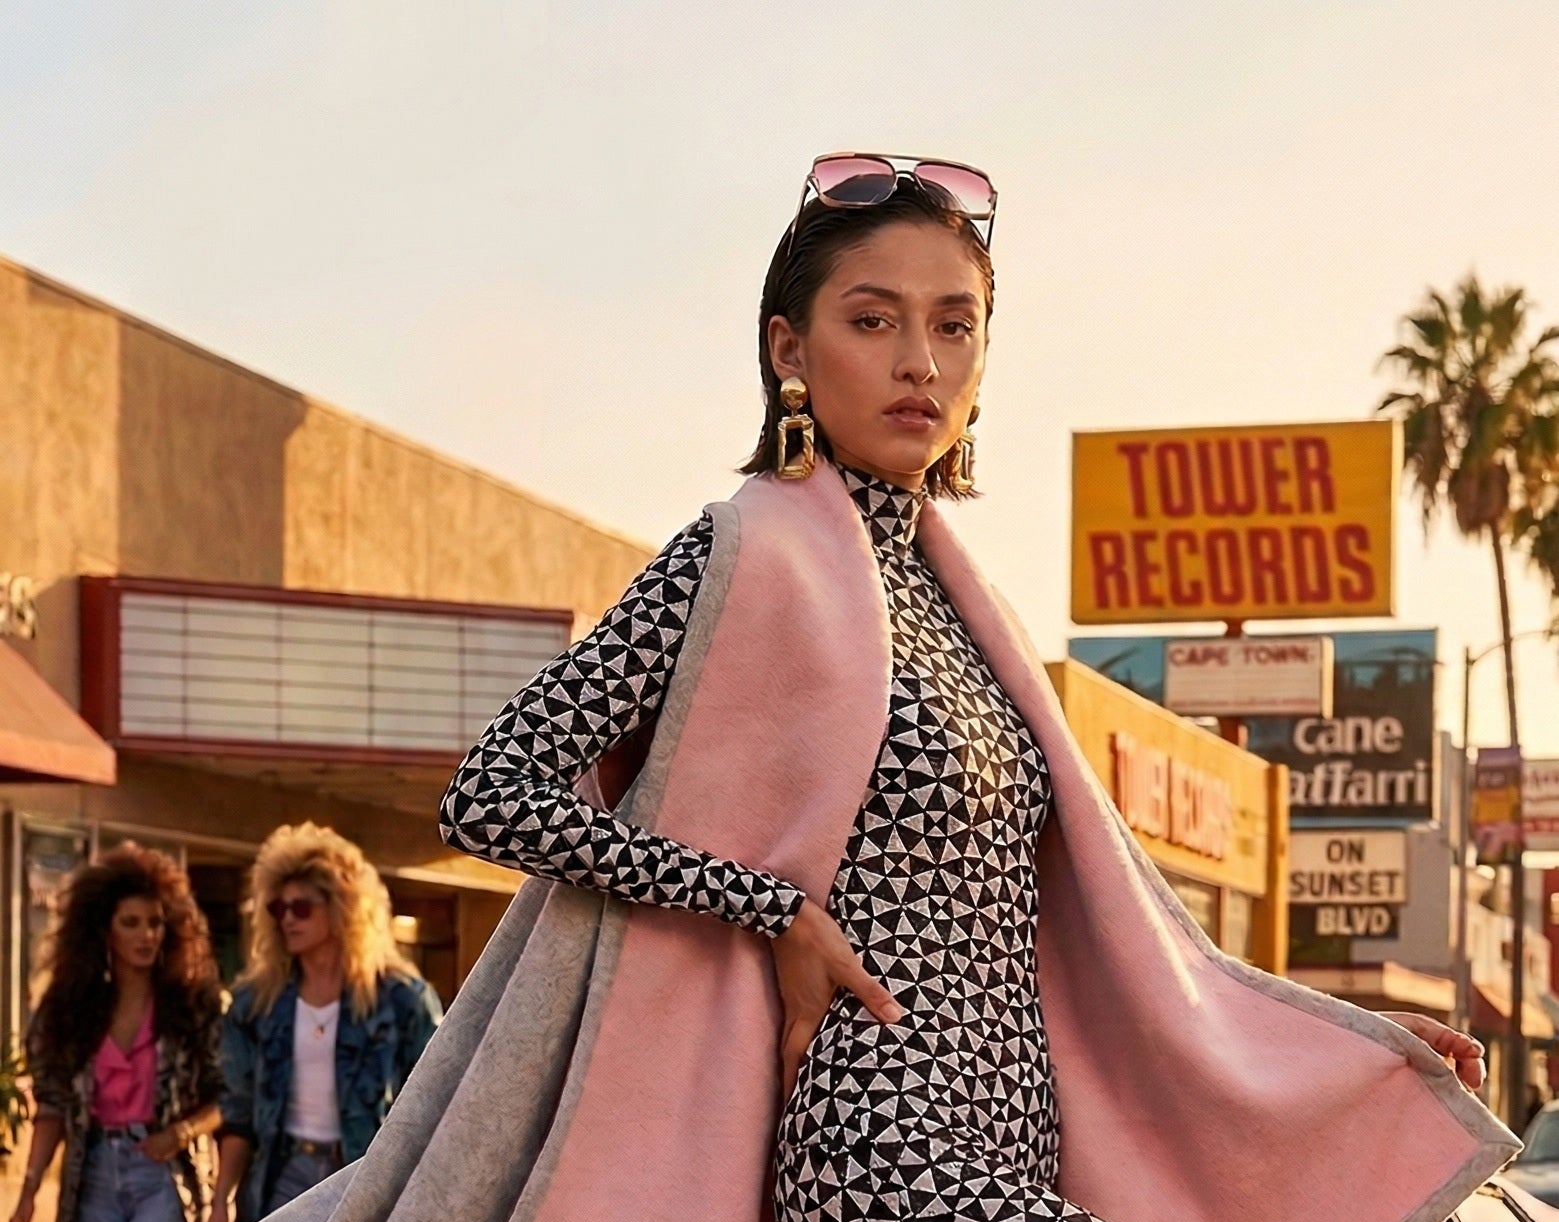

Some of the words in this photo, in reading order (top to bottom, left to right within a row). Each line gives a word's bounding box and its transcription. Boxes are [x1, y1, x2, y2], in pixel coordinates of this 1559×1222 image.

[1117, 436, 1336, 519] TOWER
[1089, 523, 1376, 609] RECORDS
[1327, 839, 1364, 863] ON
[1289, 870, 1400, 896] SUNSET
[1316, 906, 1392, 936] BLVD
